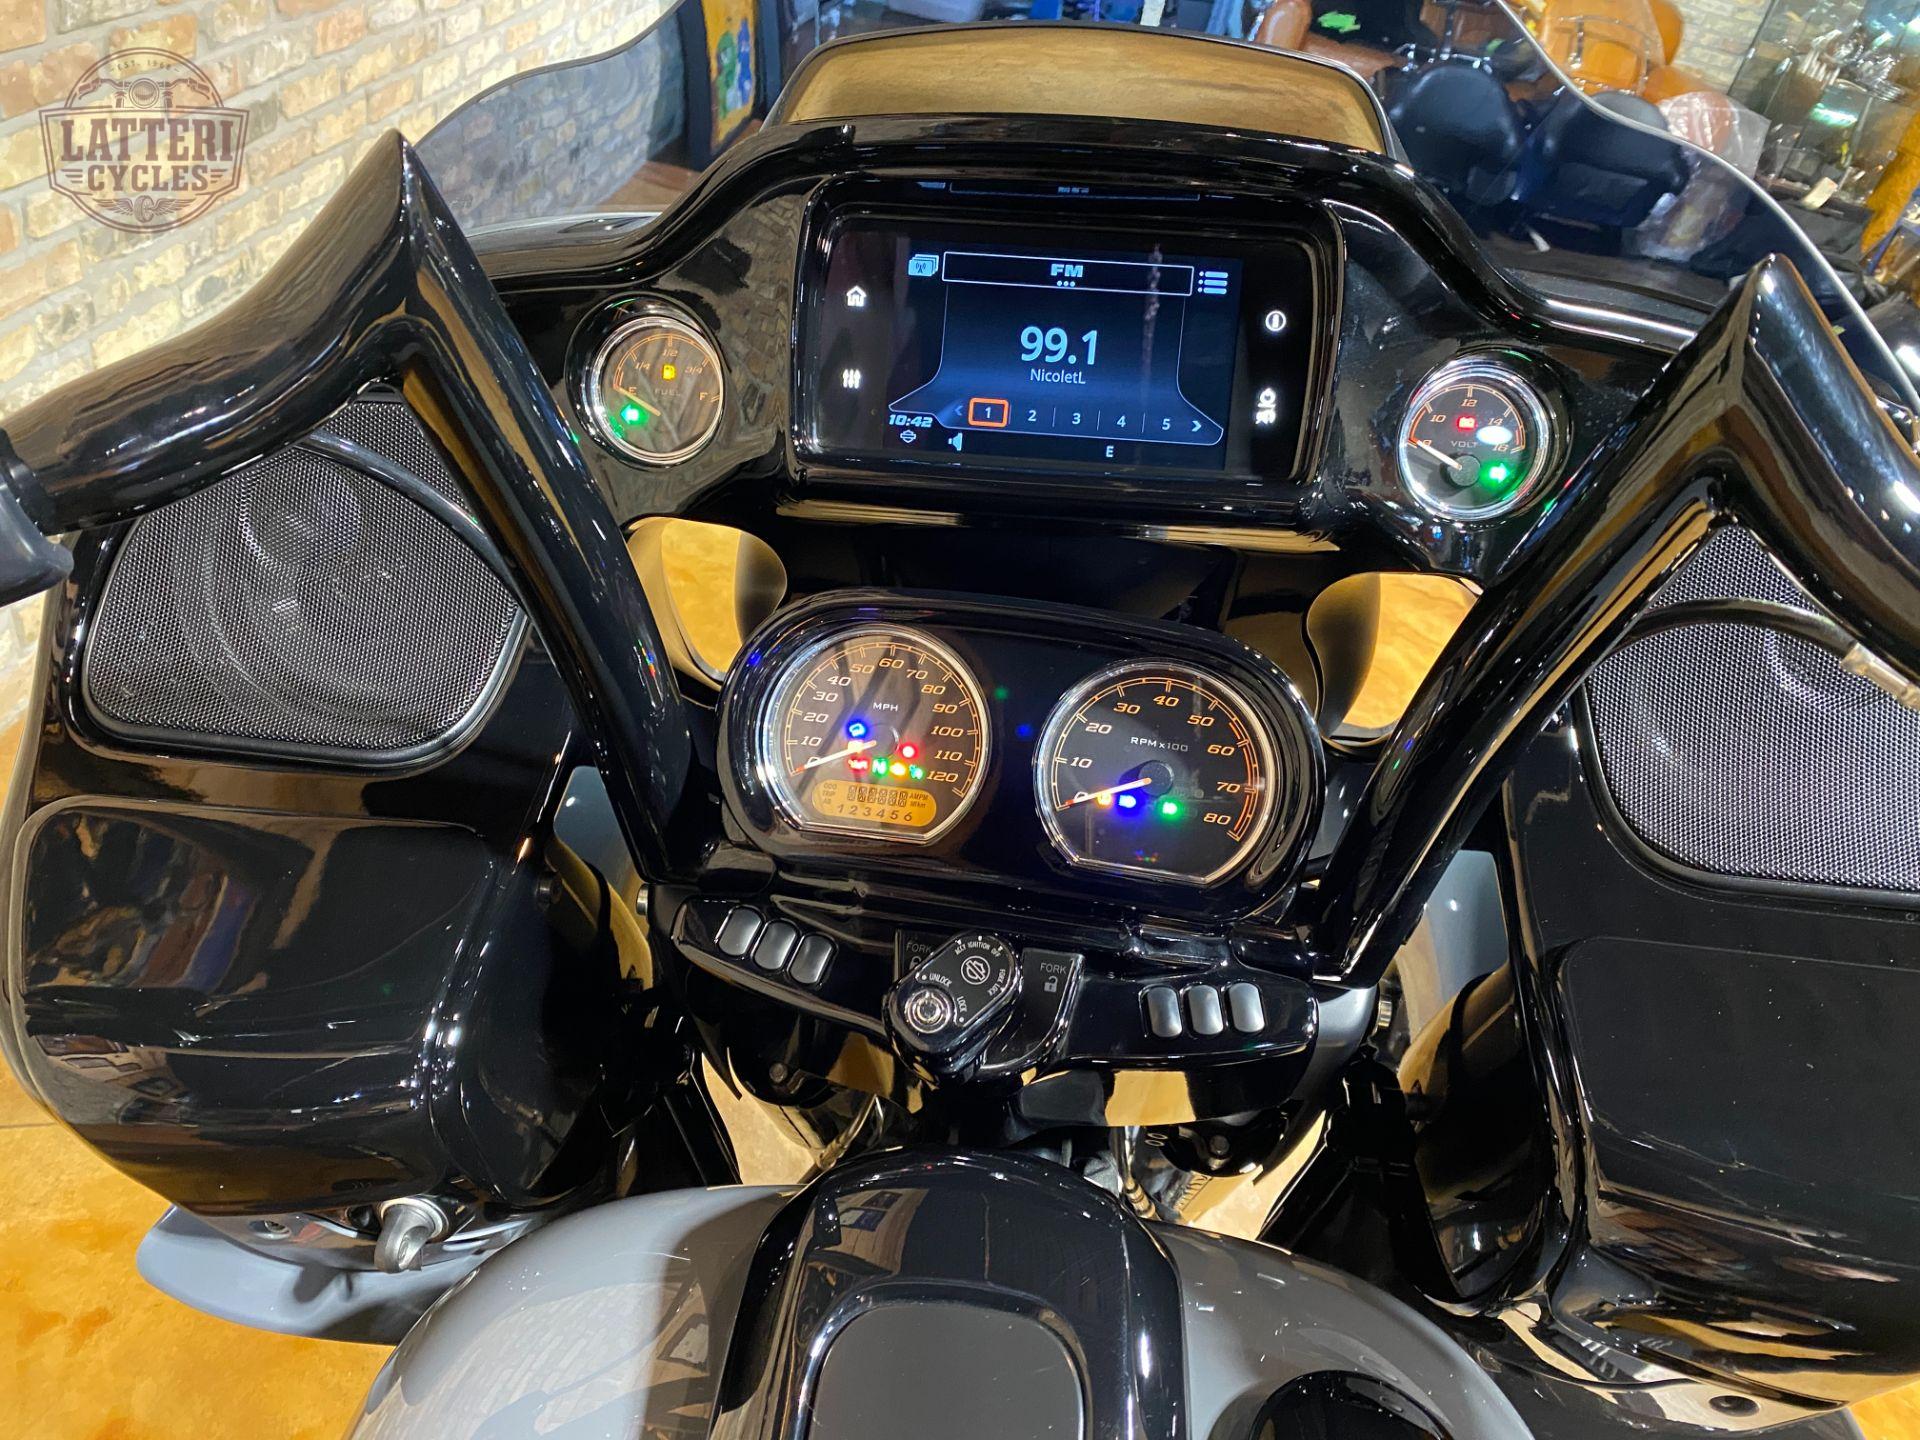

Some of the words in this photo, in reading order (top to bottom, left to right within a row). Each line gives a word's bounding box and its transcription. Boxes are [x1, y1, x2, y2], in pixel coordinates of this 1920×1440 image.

[1050, 263, 1084, 278] FM
[1020, 325, 1098, 365] 99.1
[1030, 368, 1086, 385] NicoletL
[654, 388, 681, 397] FUEL
[700, 392, 709, 401] F
[889, 414, 933, 428] 10:42
[985, 402, 992, 418] 1
[1028, 408, 1037, 422] 2
[1072, 412, 1081, 425] 3
[1116, 415, 1126, 428] 4
[1162, 418, 1171, 431] 5
[1430, 414, 1447, 423] 10
[1450, 440, 1478, 448] VOLT
[1106, 446, 1114, 458] E
[850, 663, 875, 674] 50
[879, 658, 904, 669] 60
[906, 669, 928, 680] 70
[827, 676, 851, 686] 40
[921, 685, 945, 695] 80
[812, 692, 838, 702] 30
[1153, 695, 1179, 707] 40
[873, 702, 898, 711] MPH
[933, 703, 957, 713] 90
[1113, 702, 1141, 714] 30
[803, 713, 828, 723] 20
[1187, 715, 1215, 727] 50
[931, 726, 964, 737] 100
[1085, 723, 1112, 734] 20
[800, 736, 822, 746] 10
[934, 750, 963, 761] 110
[1207, 744, 1235, 756] 60
[1070, 756, 1093, 768] 10
[927, 771, 959, 783] 120
[1216, 782, 1240, 793] 70
[1203, 813, 1231, 825] 80
[967, 941, 991, 951] IGNITION
[1040, 962, 1067, 975] FORK
[929, 972, 953, 988] UNLOCK
[956, 995, 968, 1012] LOCK
